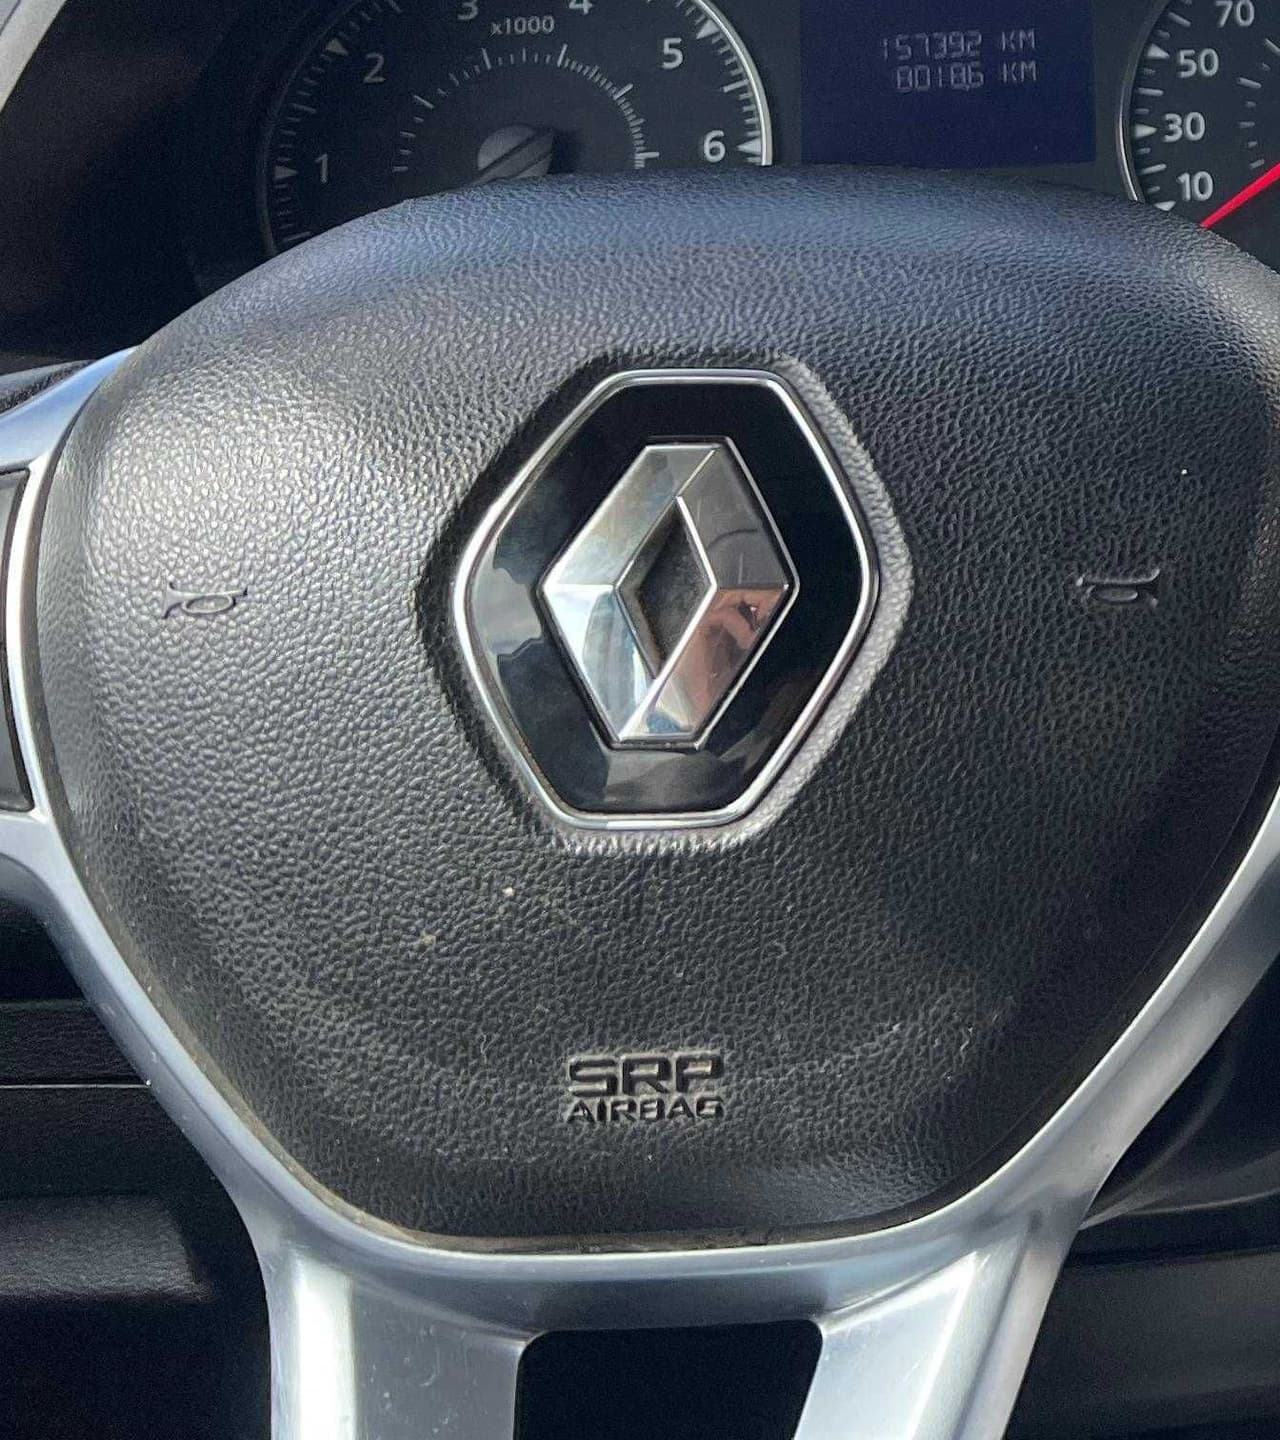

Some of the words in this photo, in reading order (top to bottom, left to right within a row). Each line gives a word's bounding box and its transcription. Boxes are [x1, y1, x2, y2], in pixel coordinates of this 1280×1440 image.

[491, 15, 556, 35] x1000
[1000, 29, 1036, 51] KM
[363, 52, 385, 83] 2
[662, 37, 683, 69] 5
[1178, 48, 1219, 78] 50
[1002, 60, 1037, 83] KM
[1164, 111, 1206, 142] 30
[702, 130, 726, 162] 6
[315, 153, 329, 184] 1
[1178, 171, 1214, 201] 10
[567, 1050, 725, 1098] SRP
[564, 1093, 725, 1124] AIRBAG
